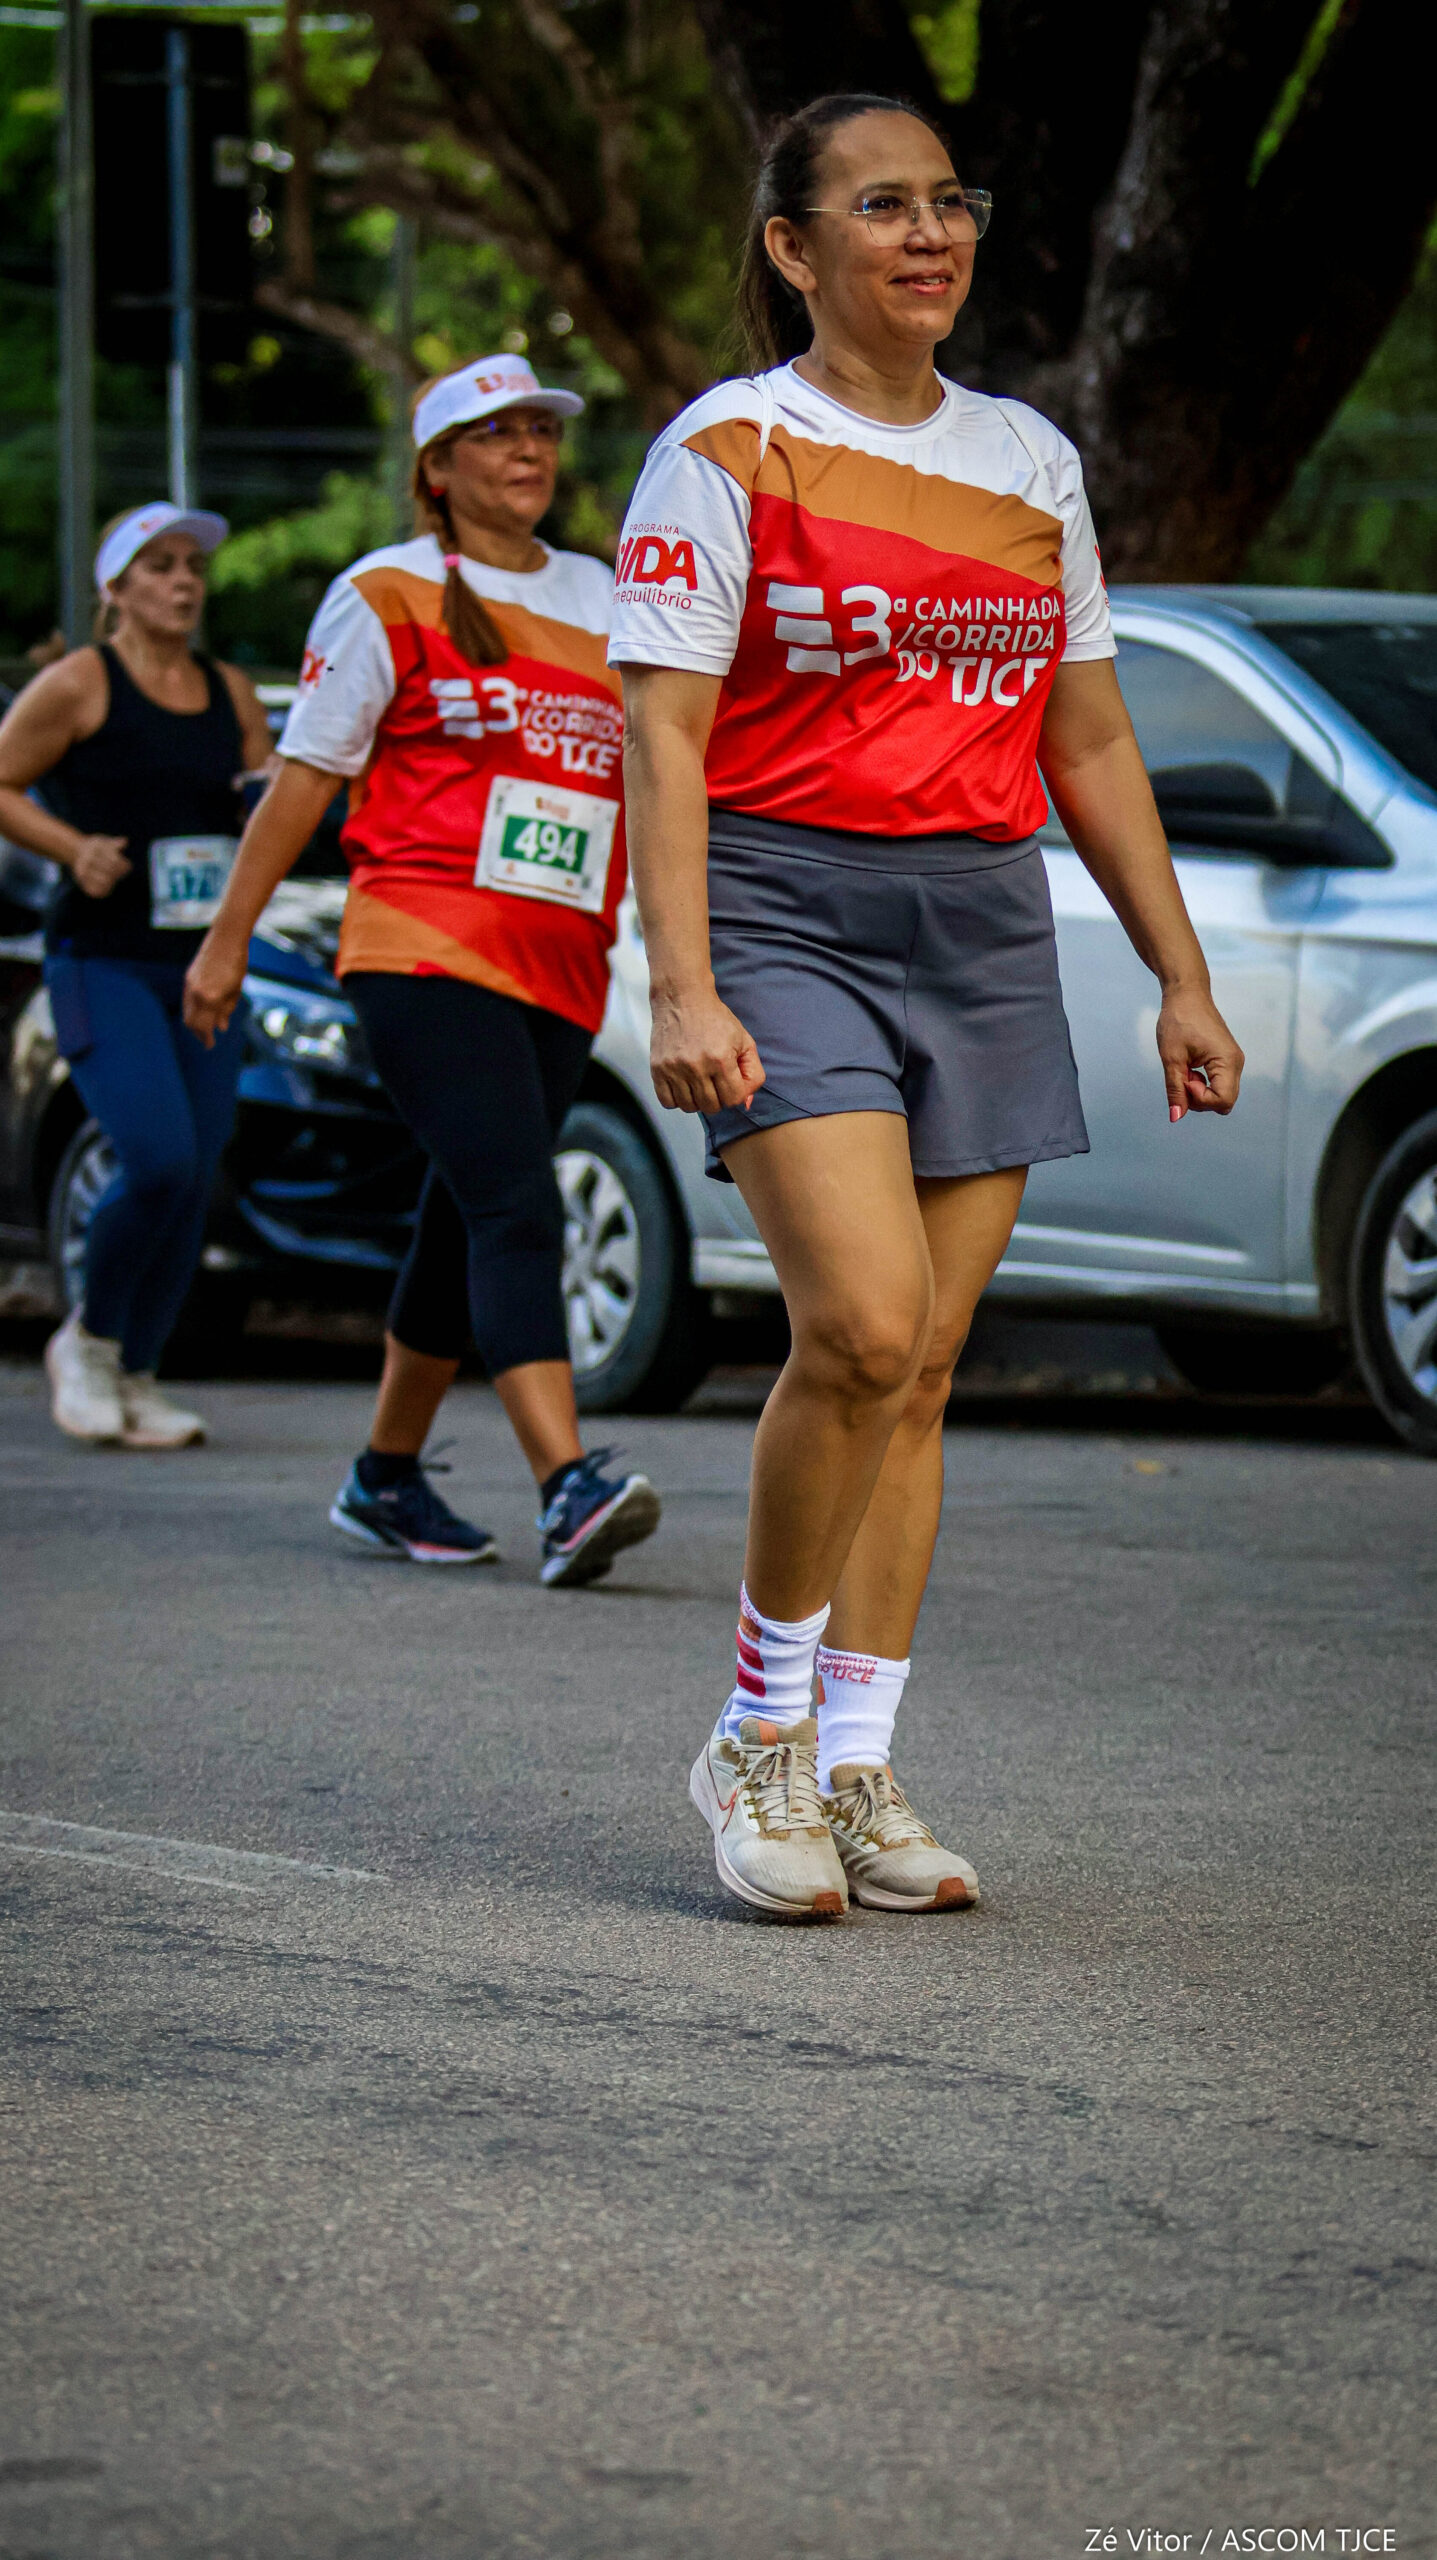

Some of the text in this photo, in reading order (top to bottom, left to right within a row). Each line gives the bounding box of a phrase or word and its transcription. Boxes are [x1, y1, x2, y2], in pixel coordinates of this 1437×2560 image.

[629, 523, 680, 536] PROGRAMA
[914, 594, 1061, 621] CAMINHADA
[894, 649, 940, 683] DO
[513, 820, 579, 869] 494
